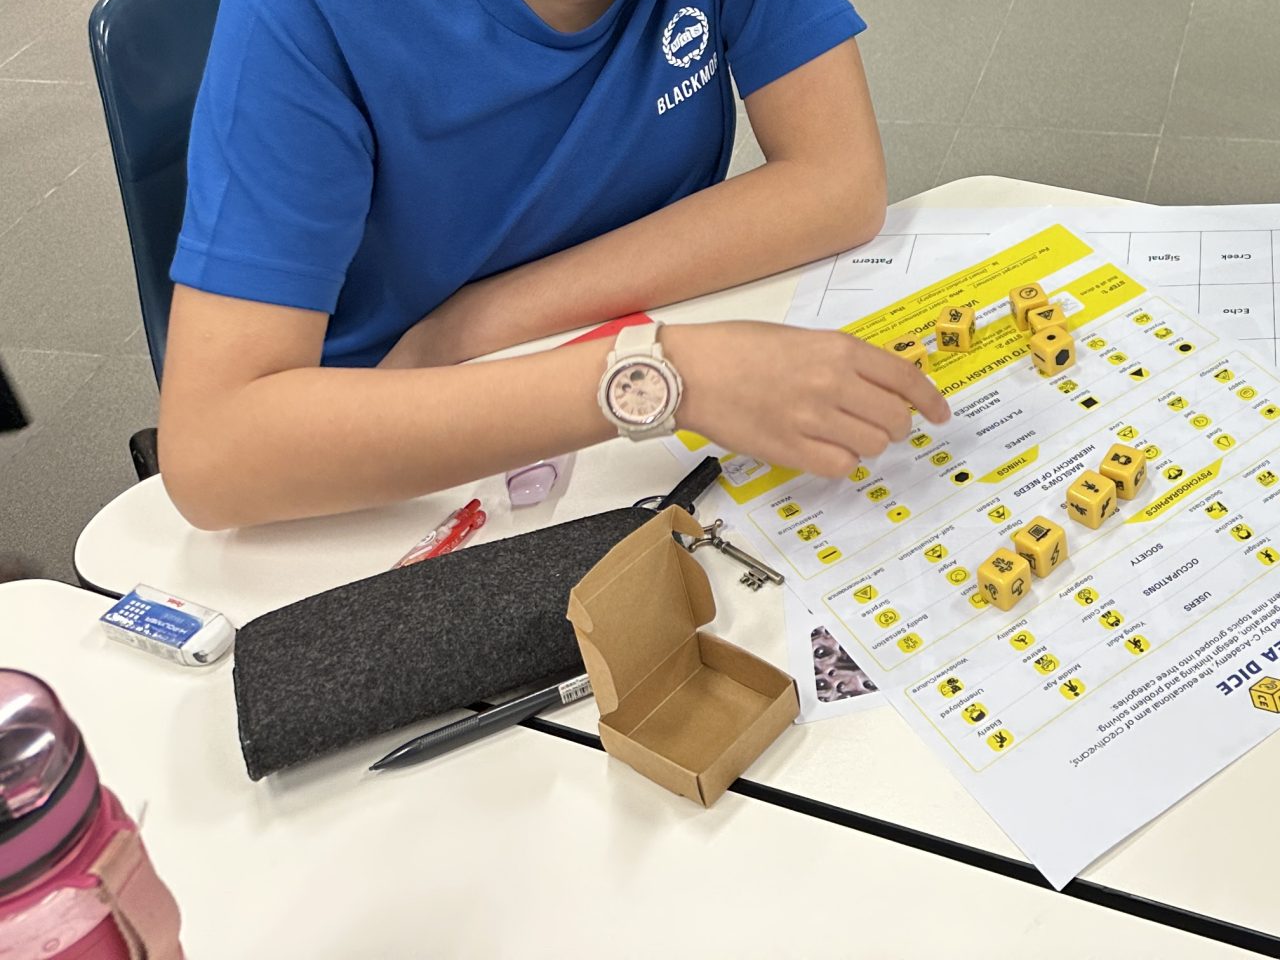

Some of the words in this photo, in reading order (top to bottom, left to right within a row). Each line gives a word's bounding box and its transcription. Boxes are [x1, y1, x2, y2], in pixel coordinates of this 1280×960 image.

[1148, 254, 1180, 262] Signal
[1011, 347, 1026, 357] TO
[965, 355, 1012, 381] UNLEASH
[950, 390, 999, 416] RESOURCES
[964, 397, 1001, 418] NATURAL
[975, 409, 1023, 436] PLATFORMS
[1004, 430, 1036, 449] SHAPES
[996, 457, 1026, 476] THINGS
[1051, 444, 1096, 474] HIERARCHY
[1040, 471, 1052, 481] OF
[1040, 462, 1085, 491] MASLOW'S
[1012, 478, 1041, 497] NEEDS
[1143, 470, 1214, 516] PSYCHOGRAPHICS
[770, 495, 792, 508] Waste
[883, 500, 896, 509] Dot
[975, 497, 1000, 512] Esteem
[997, 519, 1023, 536] Disgust
[812, 539, 828, 550] Line
[897, 524, 955, 561] Self-Actualisation
[1129, 543, 1164, 566] SOCIETY
[937, 559, 957, 573] Anger
[1142, 558, 1199, 596] OCCUPATIONS
[960, 583, 980, 596] ouch
[860, 598, 890, 618] Surprise
[1099, 598, 1115, 610] Blue
[1182, 591, 1212, 612] USERS
[1250, 601, 1269, 616] nine
[906, 613, 928, 629] Bodily
[1080, 608, 1101, 623] Collar
[1225, 613, 1253, 633] topics
[996, 619, 1028, 640] Disability
[1122, 620, 1146, 635] Young
[1256, 624, 1272, 635] by
[871, 627, 906, 650] Sensation
[1106, 633, 1125, 647] Adult
[1193, 629, 1228, 656] grouped
[1211, 635, 1240, 656] design
[1021, 645, 1047, 663] Retiree
[1209, 632, 1261, 668] C-Academy,
[1176, 653, 1195, 667] into
[1177, 653, 1213, 678] thinking
[911, 657, 968, 694] Worldview/Culture
[1057, 663, 1081, 681] Middle
[1154, 664, 1179, 682] three
[1197, 667, 1214, 679] the
[1215, 660, 1262, 695] DICE
[1042, 679, 1058, 691] Age
[1163, 675, 1181, 690] and
[939, 687, 984, 718] Unemployed
[1110, 678, 1156, 711] categories:
[1129, 685, 1165, 712] problem
[1151, 676, 1199, 711] educational
[1095, 709, 1131, 734] solving.
[1134, 707, 1153, 722] arm
[976, 718, 1002, 737] Elderly
[1124, 719, 1135, 730] of
